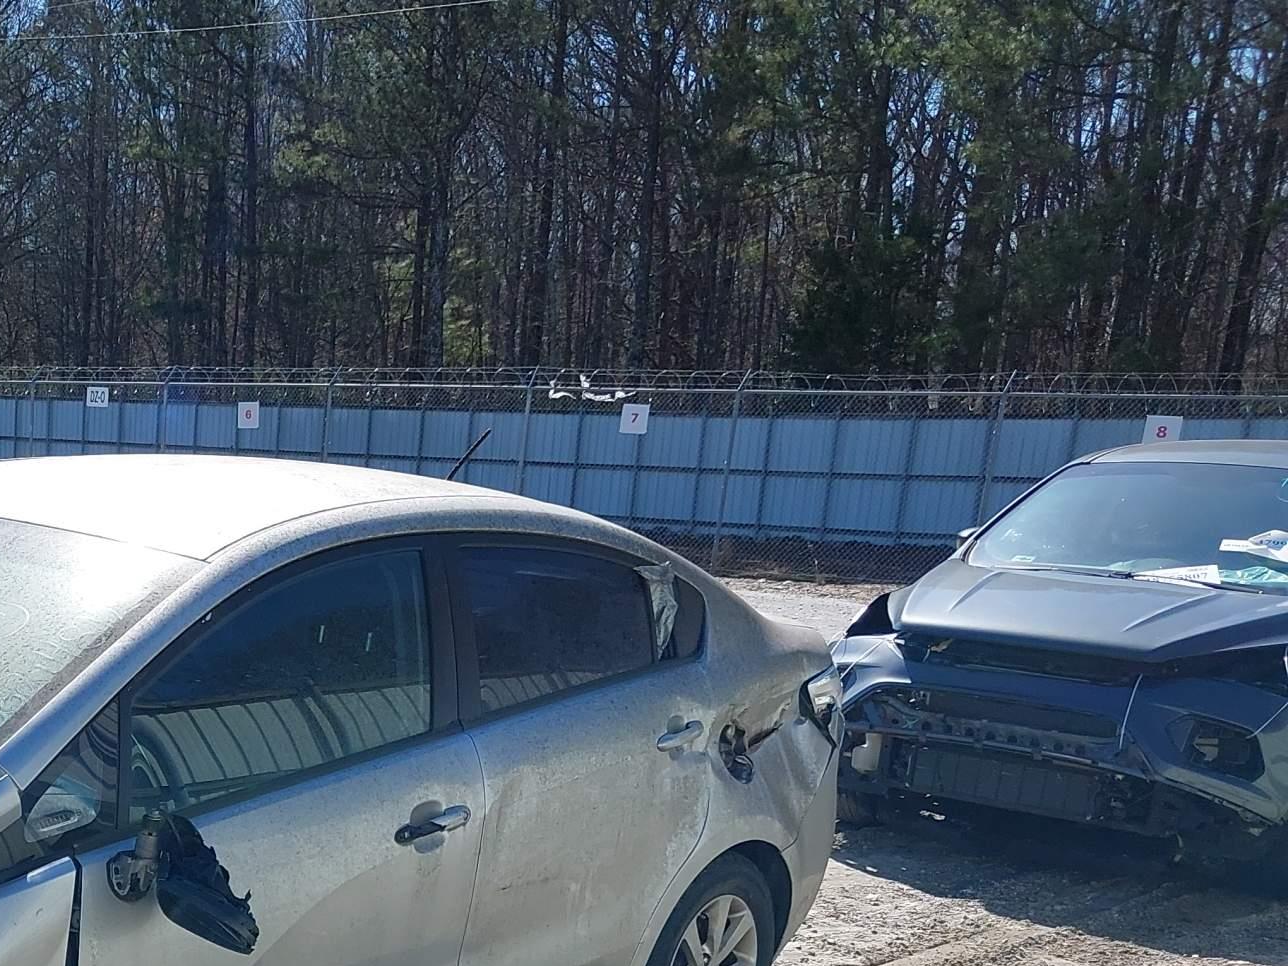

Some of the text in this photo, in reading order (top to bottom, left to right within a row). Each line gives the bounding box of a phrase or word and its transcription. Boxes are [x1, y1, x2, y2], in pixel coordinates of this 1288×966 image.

[245, 409, 252, 419] 6
[631, 412, 640, 424] 7
[1156, 425, 1168, 439] 8
